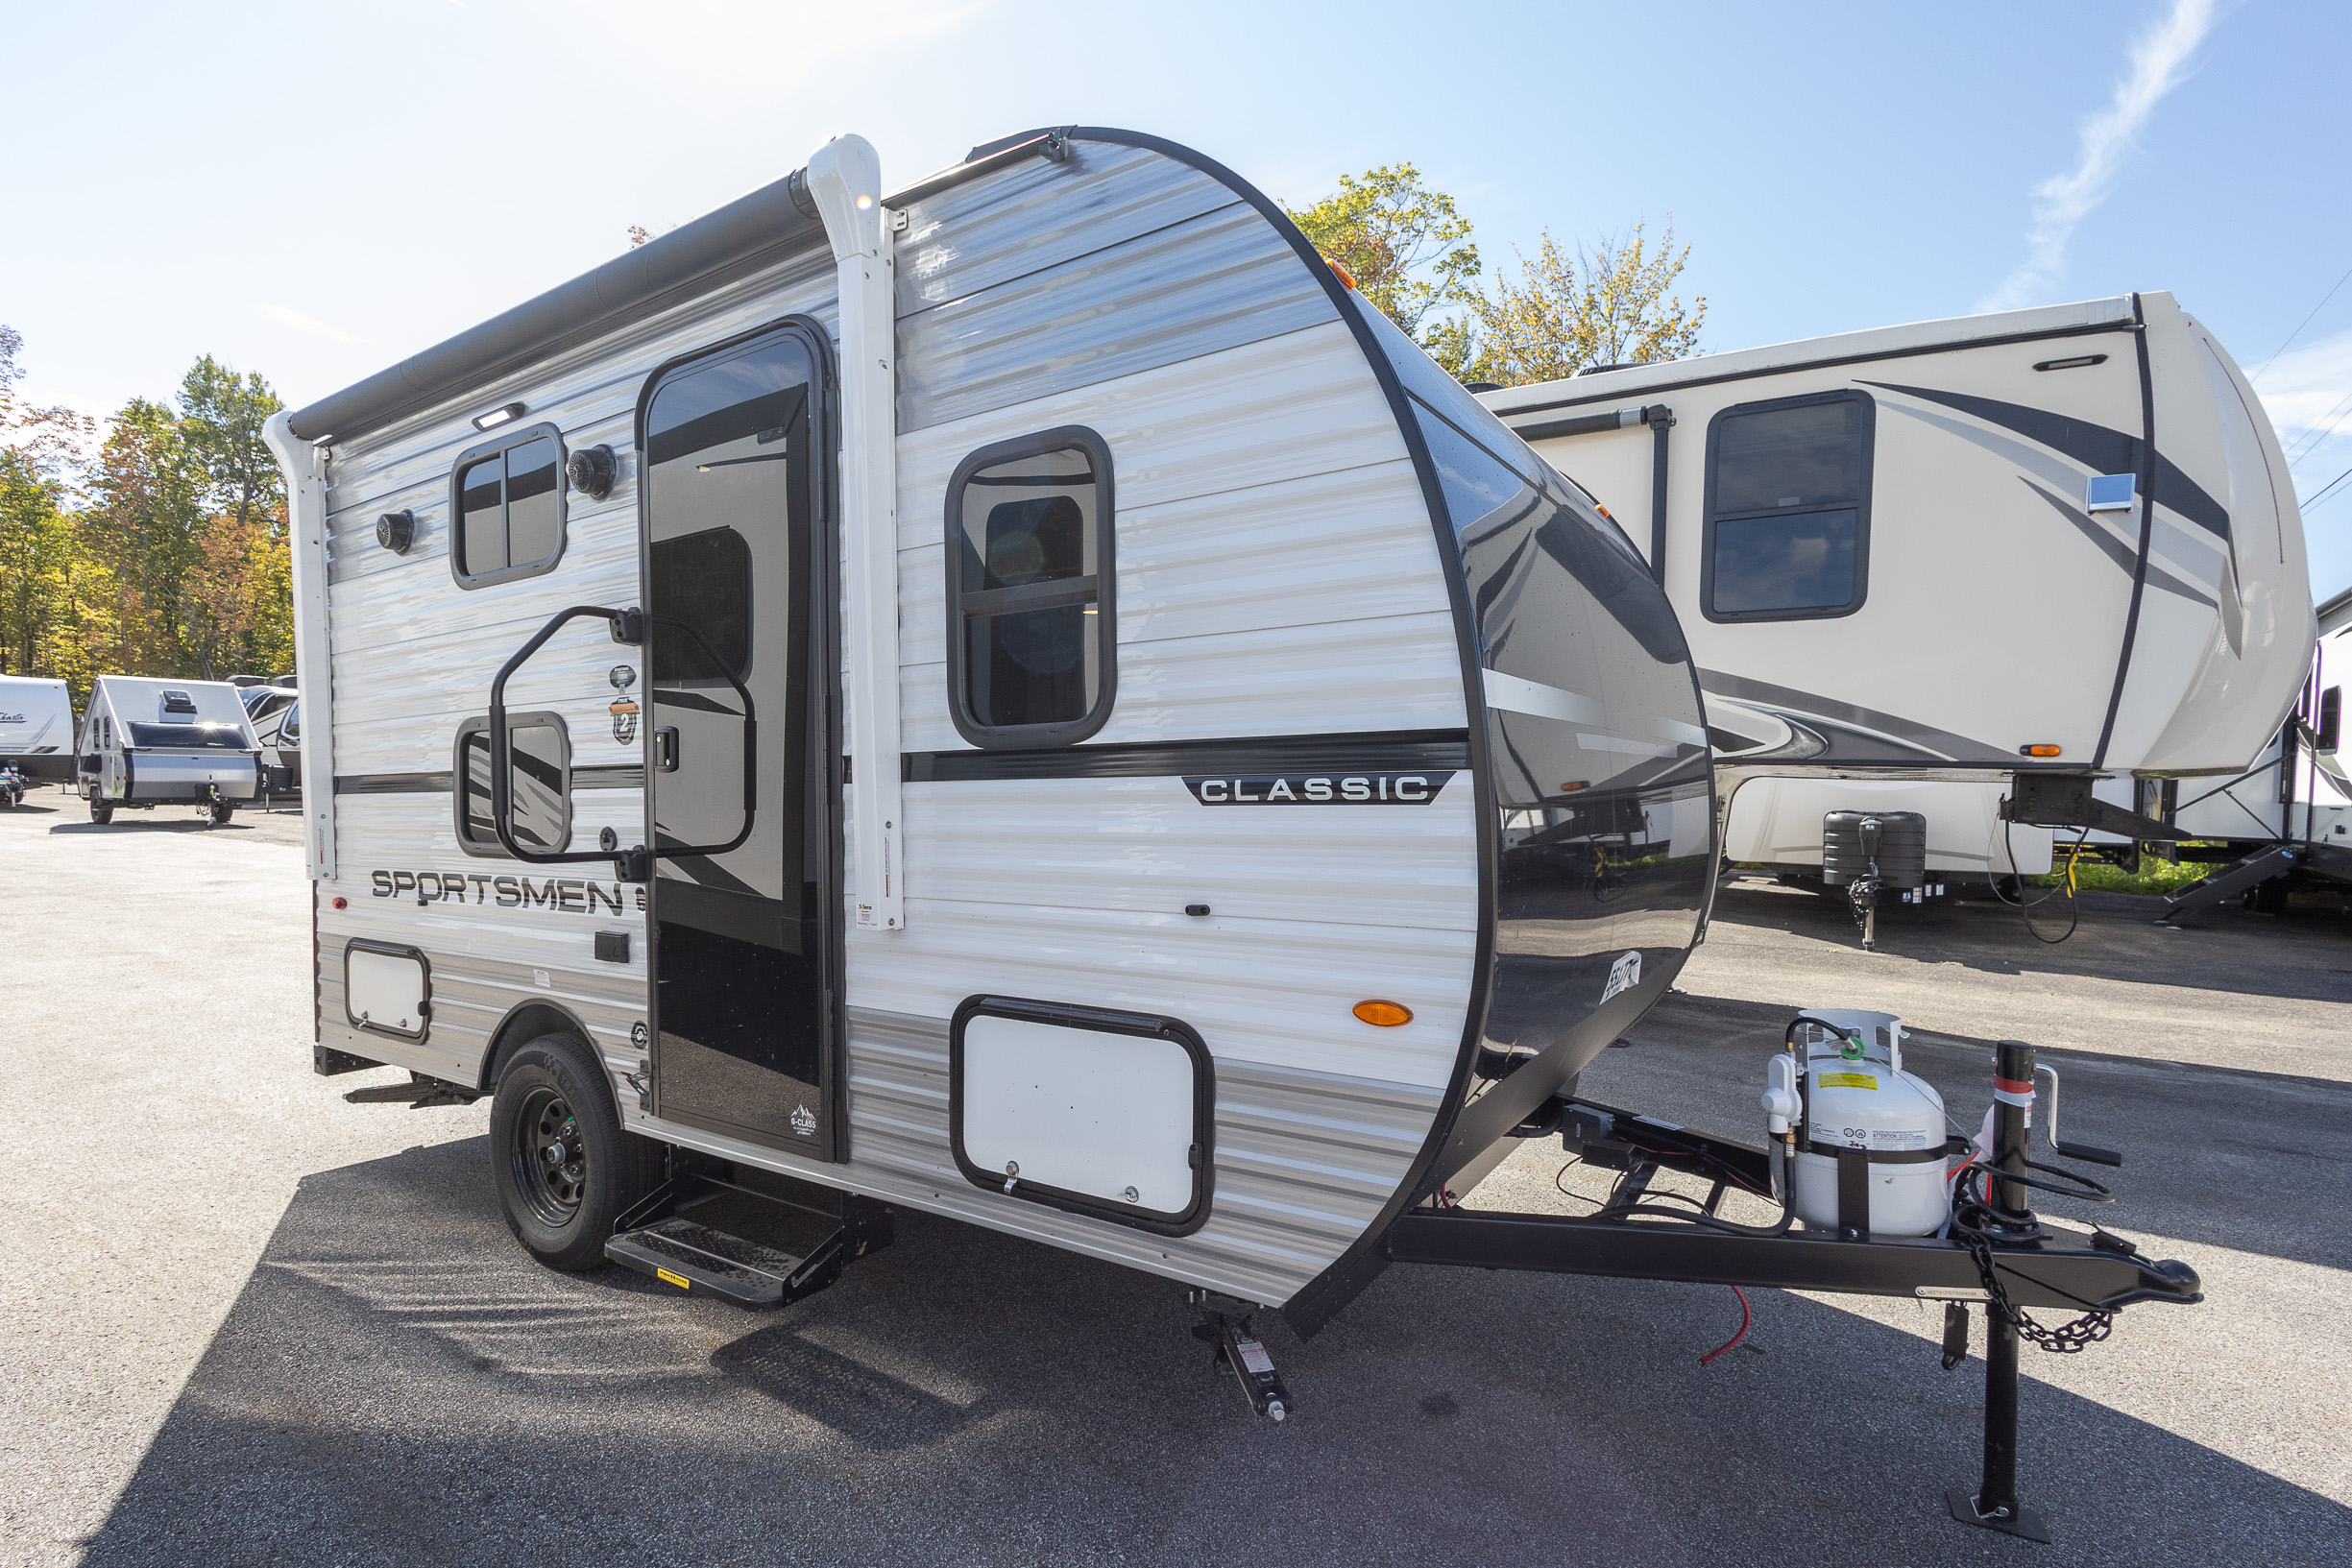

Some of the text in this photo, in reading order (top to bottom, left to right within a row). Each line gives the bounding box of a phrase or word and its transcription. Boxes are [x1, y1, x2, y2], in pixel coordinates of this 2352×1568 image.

[619, 713, 629, 733] 2
[1200, 776, 1428, 802] CLASSIC
[371, 870, 623, 917] SPORTSMEN
[790, 1118, 816, 1129] G-CLASS
